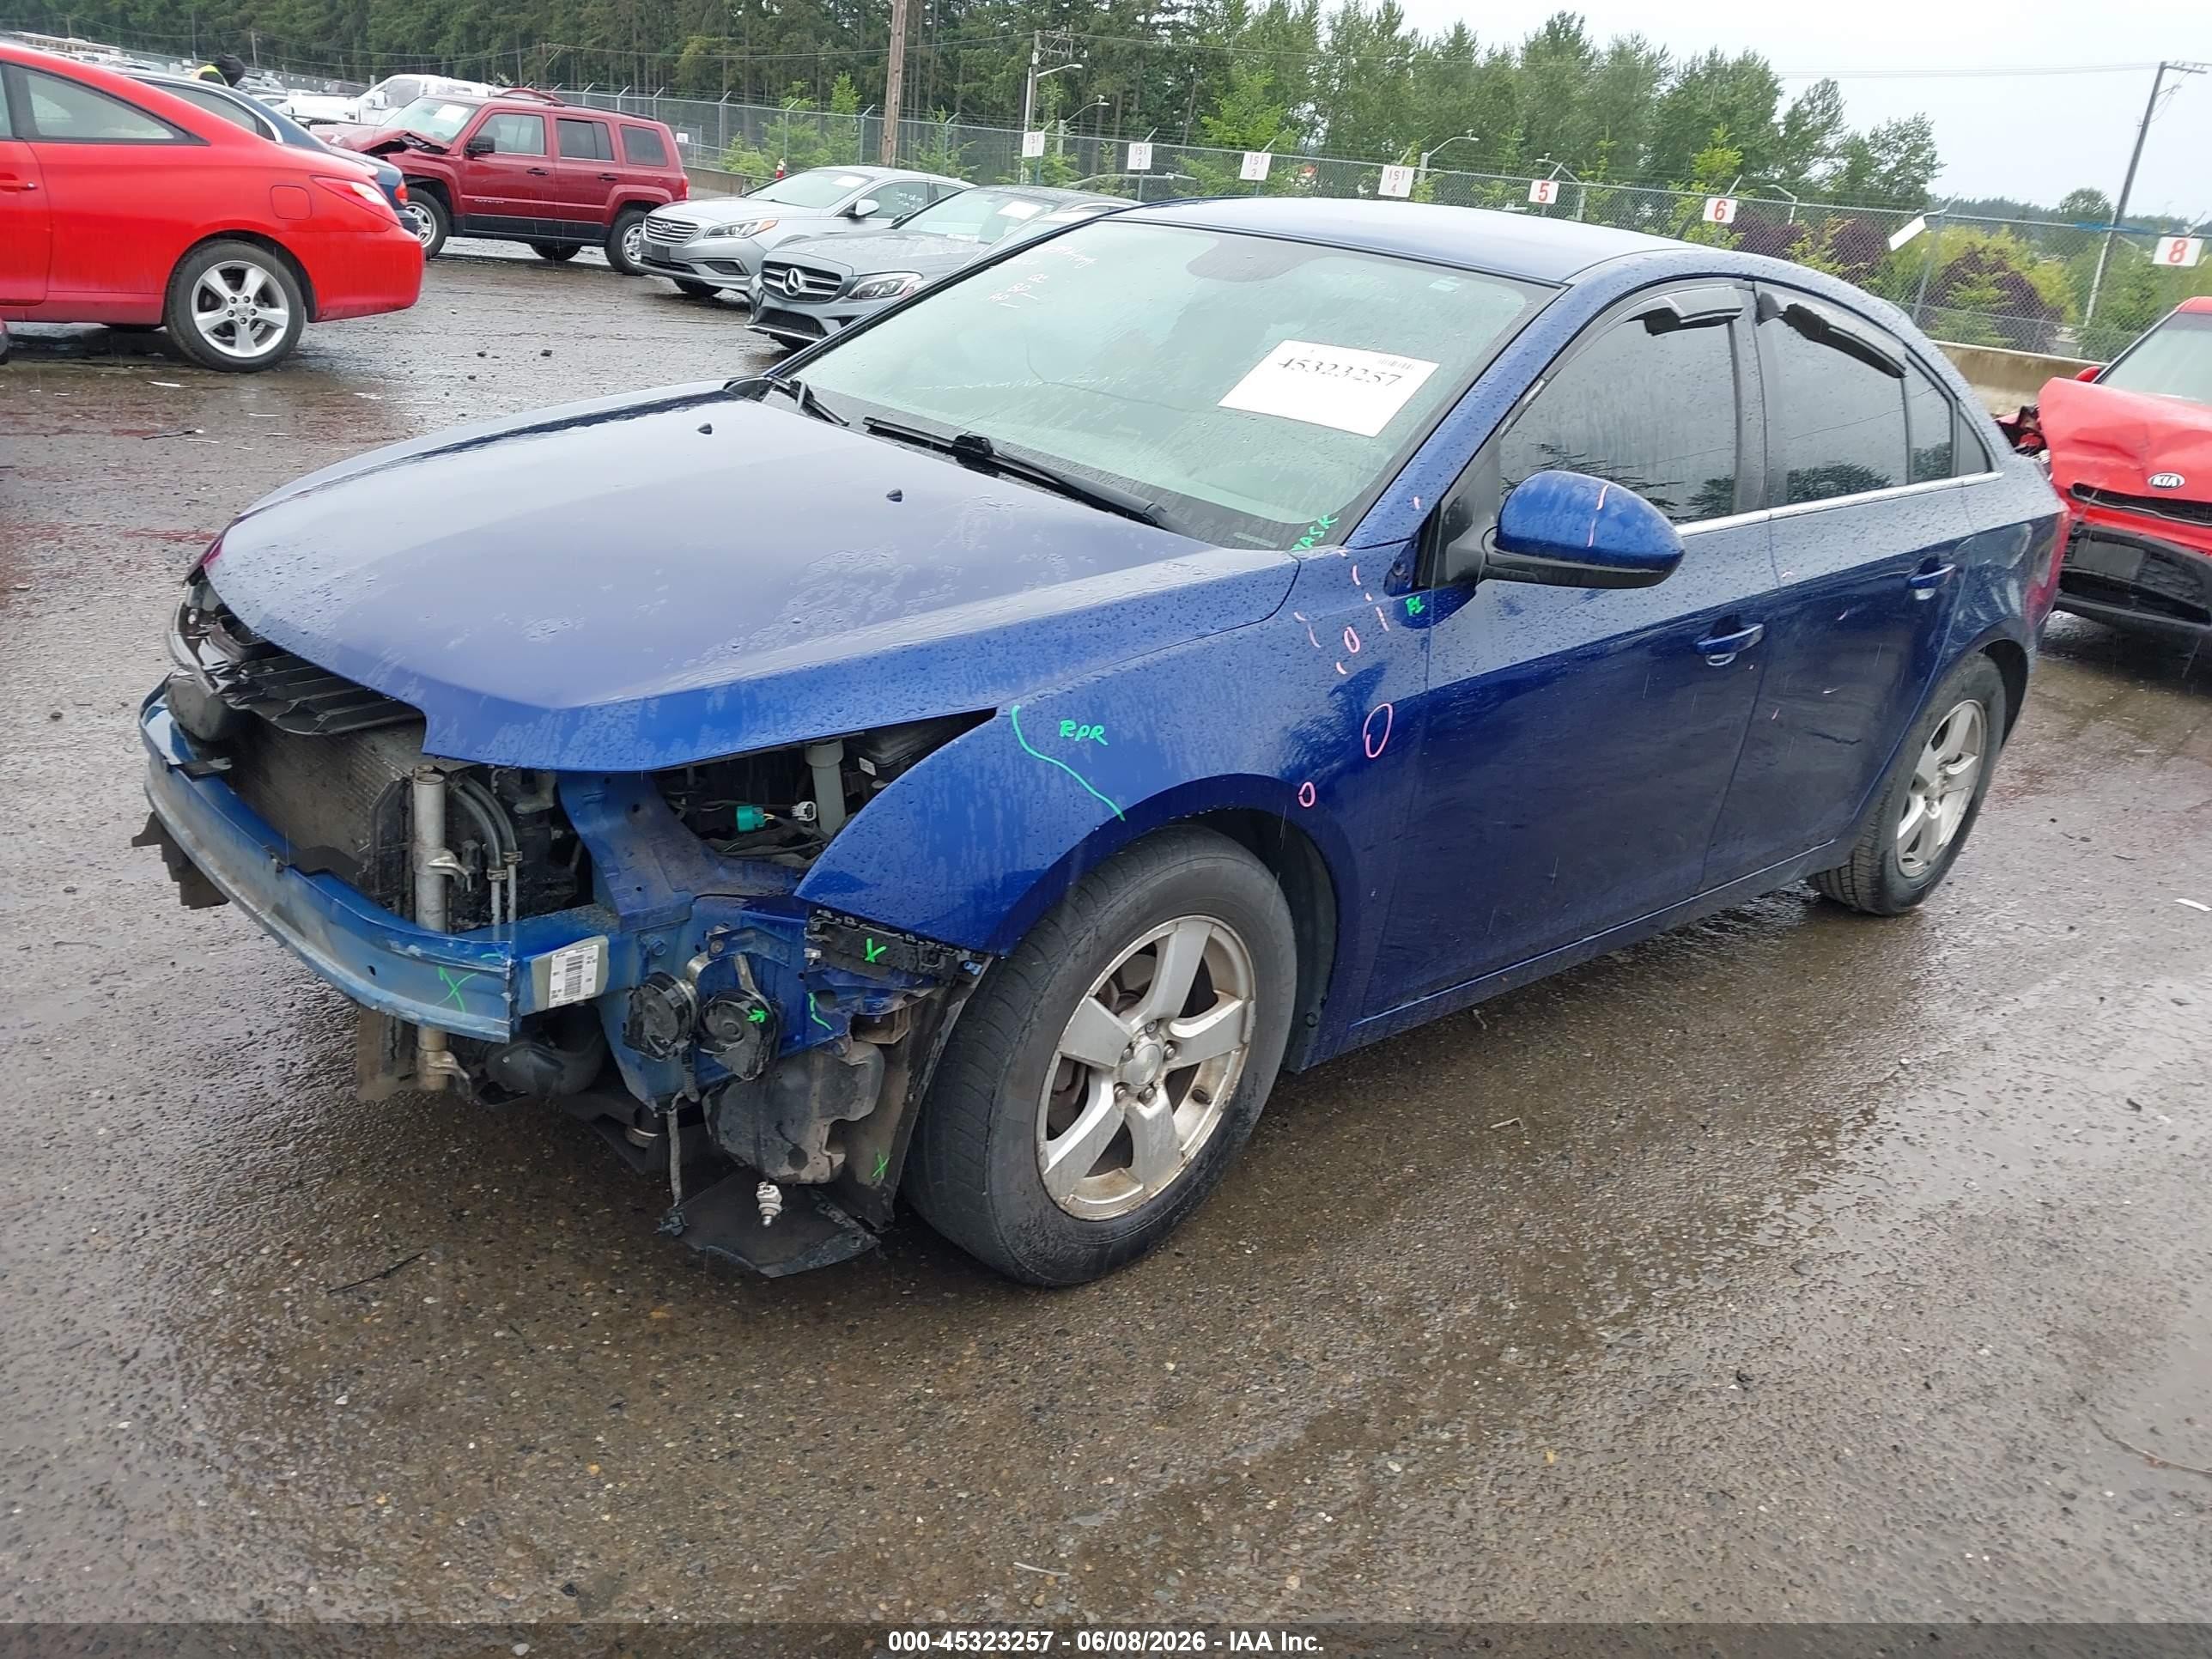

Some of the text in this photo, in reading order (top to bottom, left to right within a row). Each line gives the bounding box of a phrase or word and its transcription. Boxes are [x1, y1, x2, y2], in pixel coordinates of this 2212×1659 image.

[1391, 184, 1397, 193] 4
[1538, 182, 1550, 201] 5
[1714, 200, 1727, 221] 6
[2168, 240, 2187, 264] 8
[1278, 357, 1402, 386] 45323257
[2151, 475, 2179, 488] KIA
